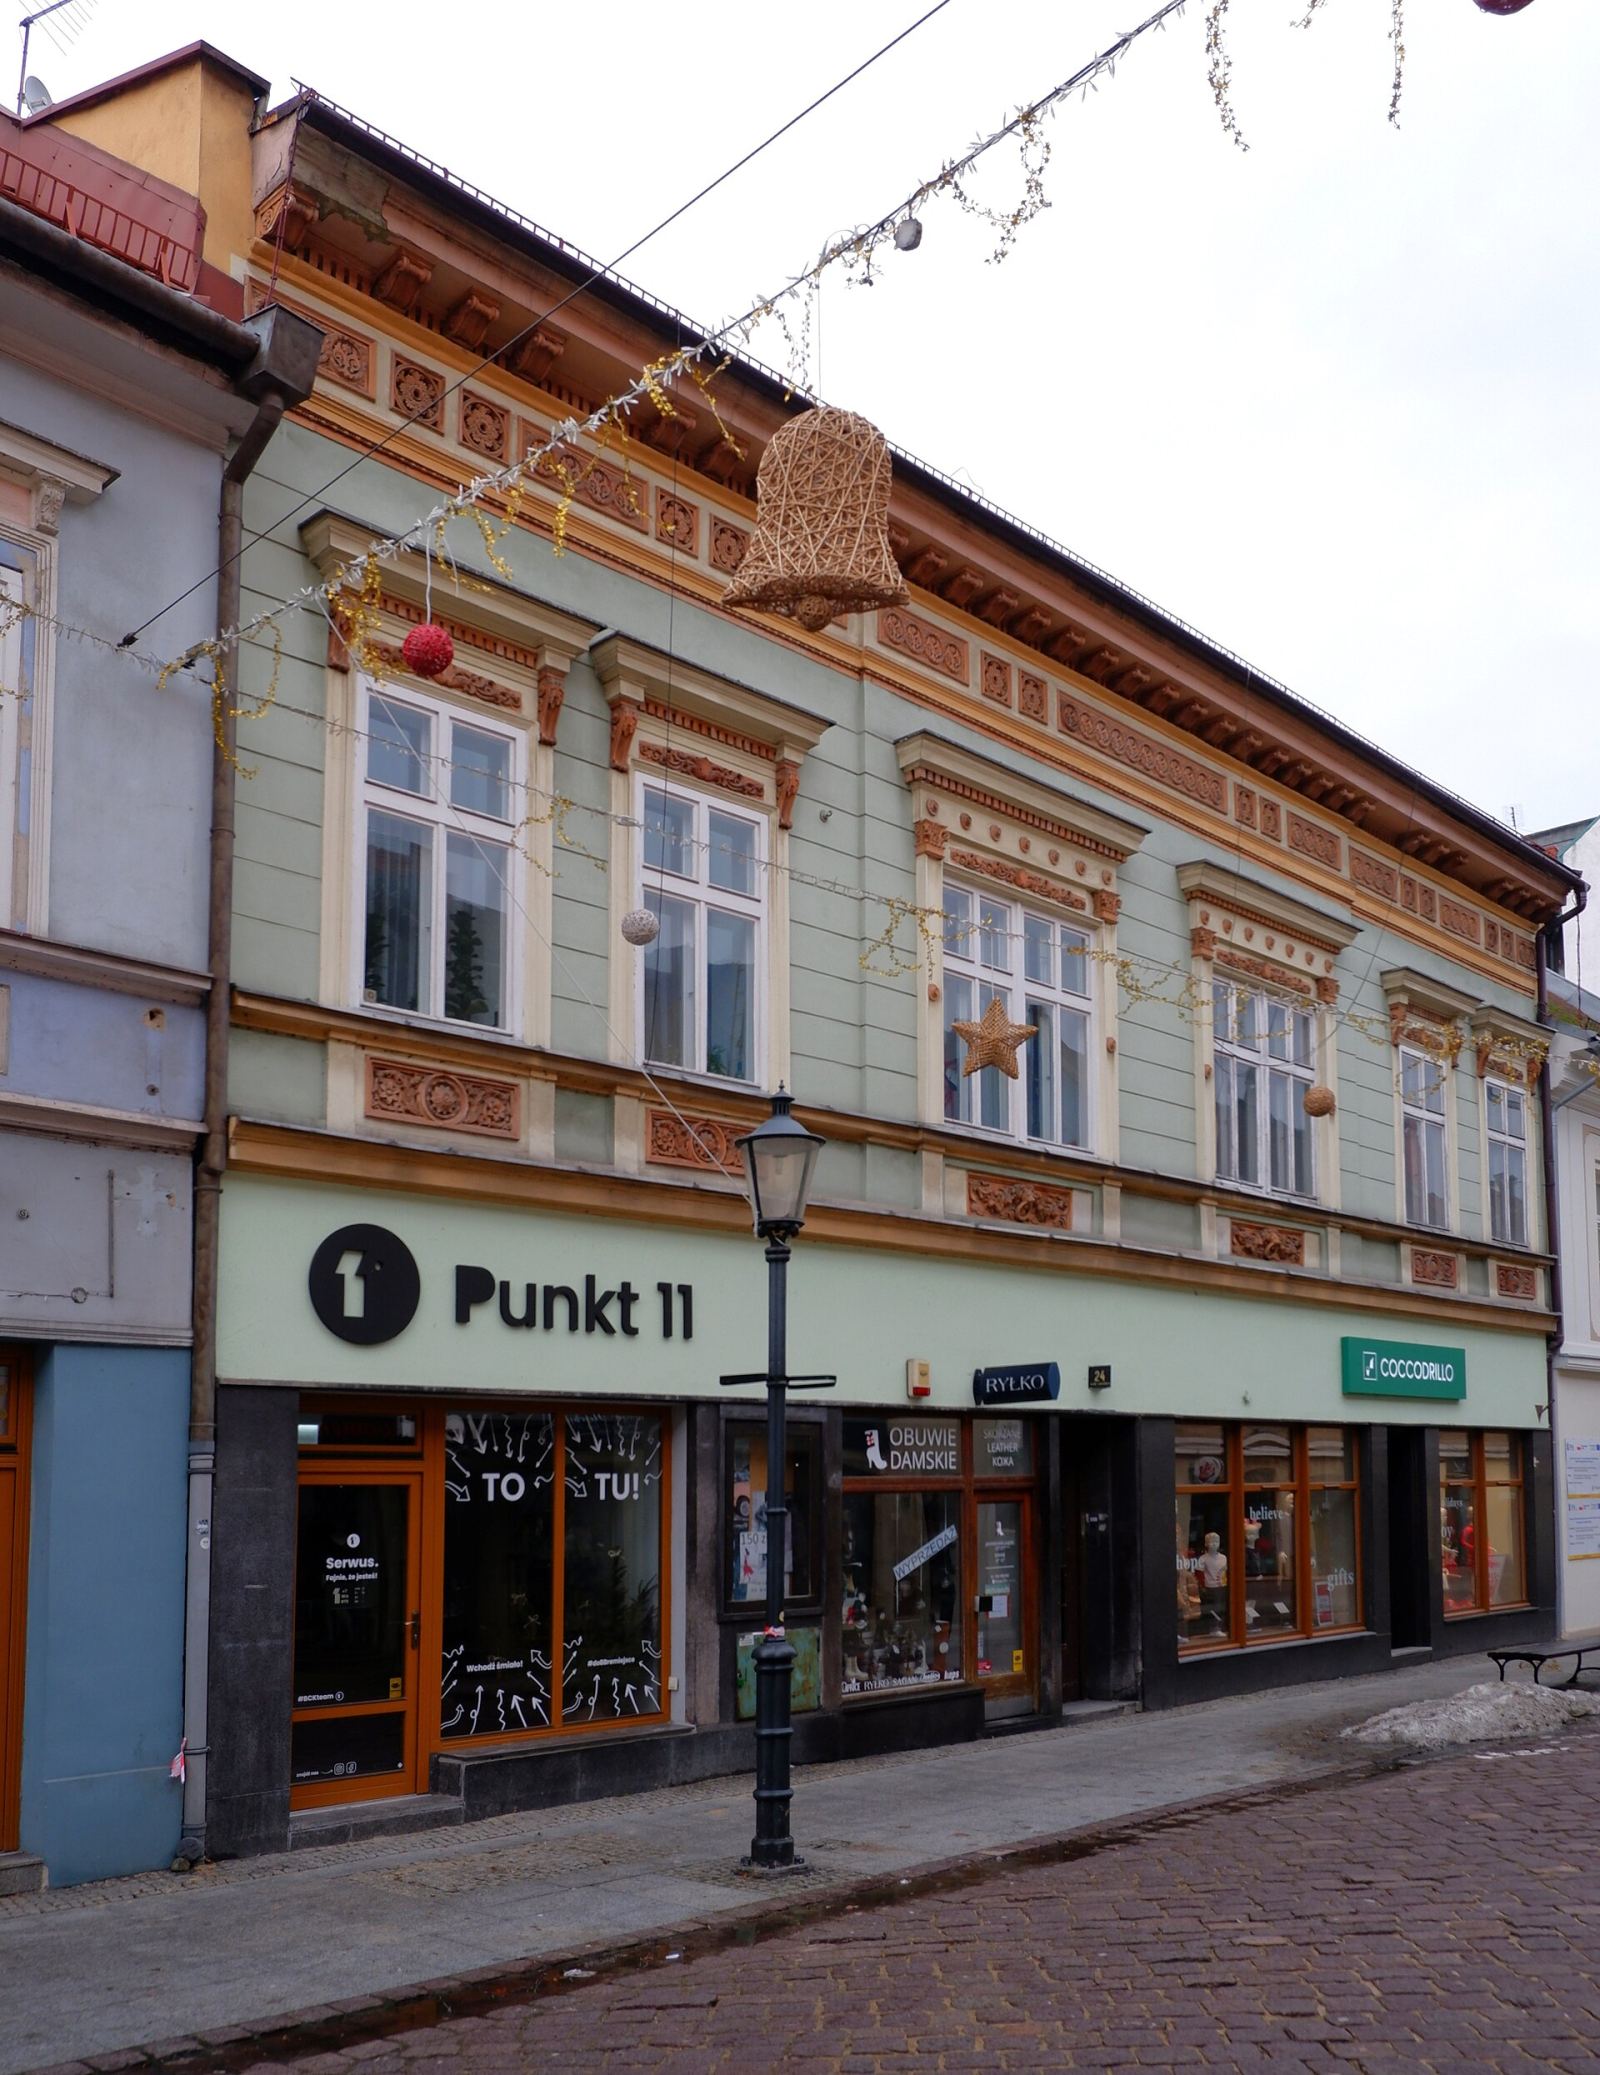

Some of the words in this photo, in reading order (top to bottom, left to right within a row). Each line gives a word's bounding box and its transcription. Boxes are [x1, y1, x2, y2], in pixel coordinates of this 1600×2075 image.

[456, 1264, 639, 1337] Punkt
[657, 1281, 693, 1340] 11
[1094, 1369, 1106, 1382] 24
[1380, 1358, 1454, 1382] COCCODRILLO
[985, 1373, 1045, 1393] RYŁKO
[889, 1427, 957, 1447] OBUWIE
[987, 1442, 1018, 1454] LEATHER
[891, 1450, 957, 1471] DAMSKIE
[481, 1472, 526, 1502] TO
[594, 1472, 640, 1502] TU!
[1249, 1505, 1284, 1522] believe
[741, 1533, 759, 1546] 150
[325, 1557, 379, 1570] Serwus.
[1326, 1567, 1354, 1592] gifts
[466, 1661, 496, 1673] Wchodź
